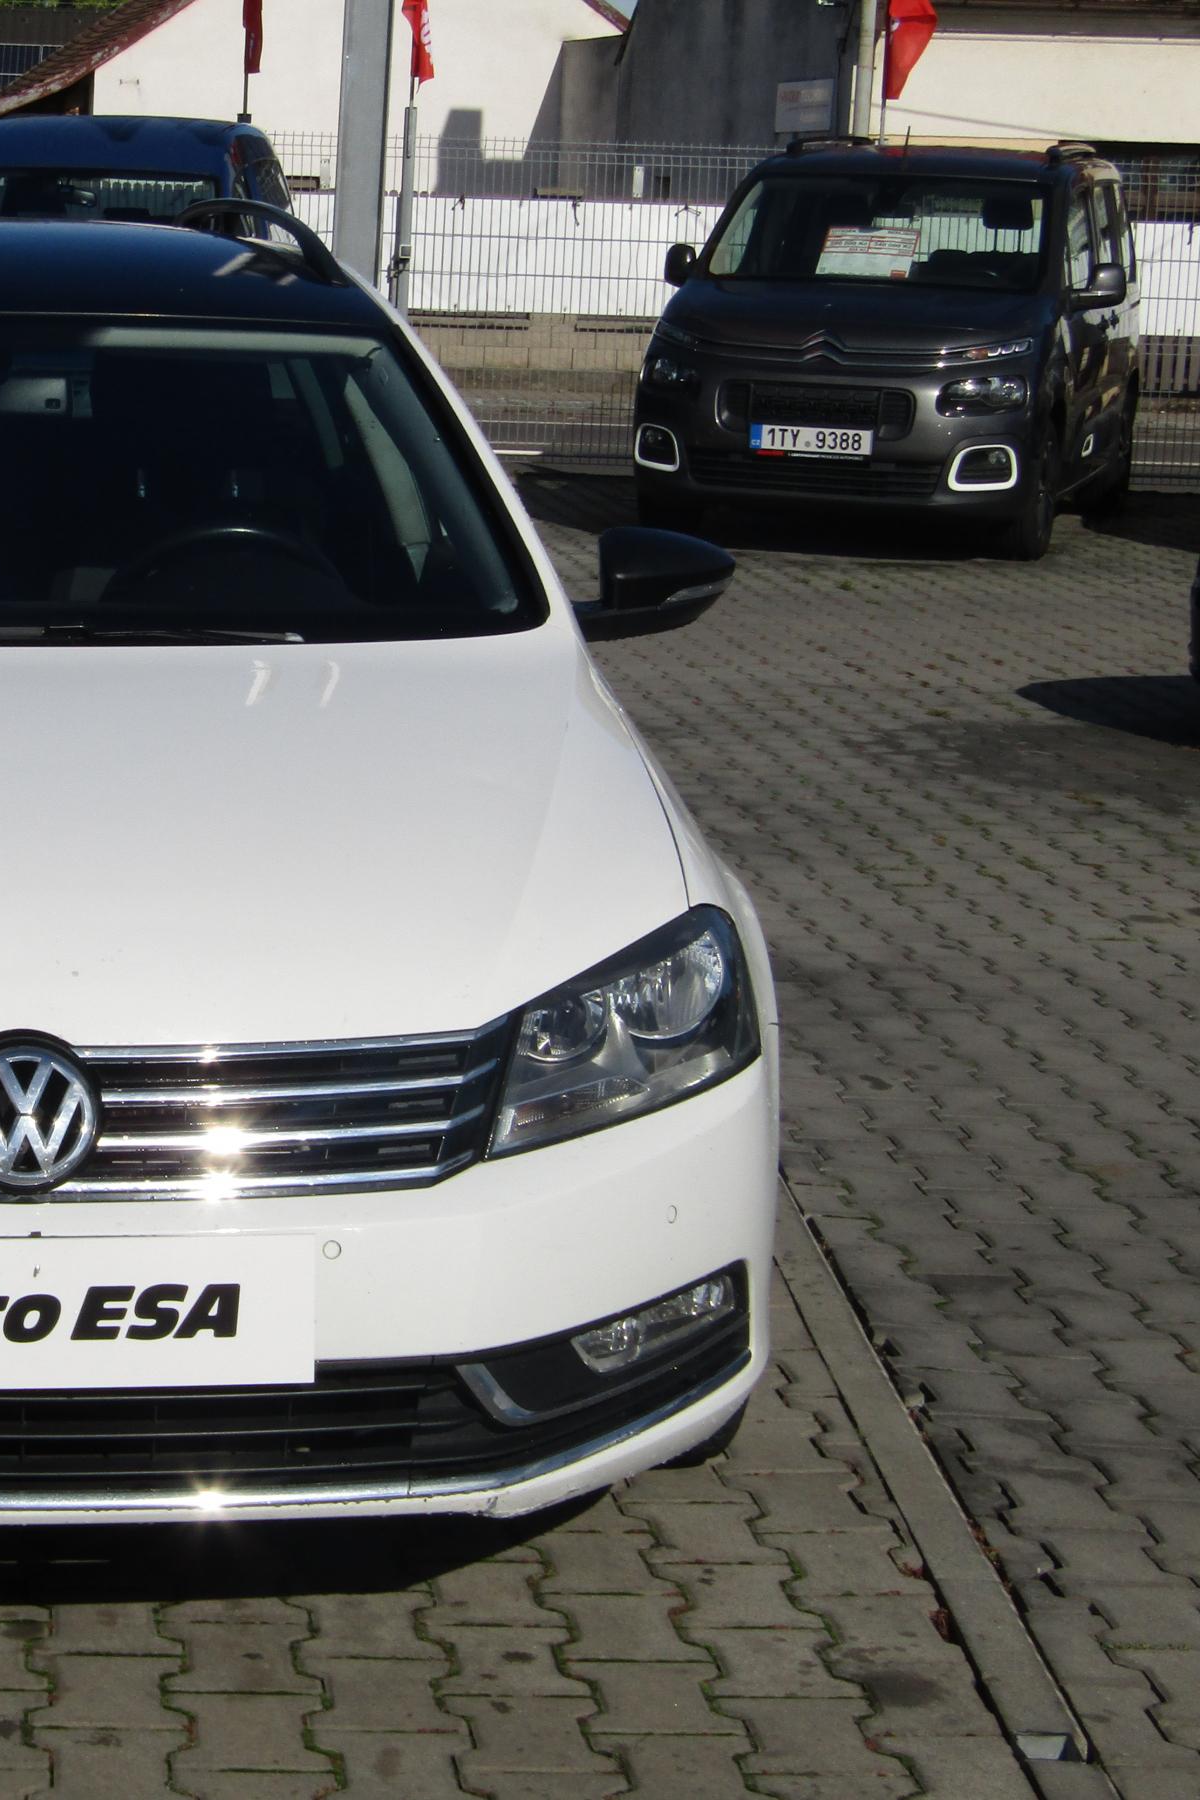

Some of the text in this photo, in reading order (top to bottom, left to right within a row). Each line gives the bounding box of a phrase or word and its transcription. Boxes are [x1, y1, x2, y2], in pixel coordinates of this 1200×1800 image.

[767, 428, 862, 451] 1TY 9388
[71, 1284, 241, 1340] ESA
